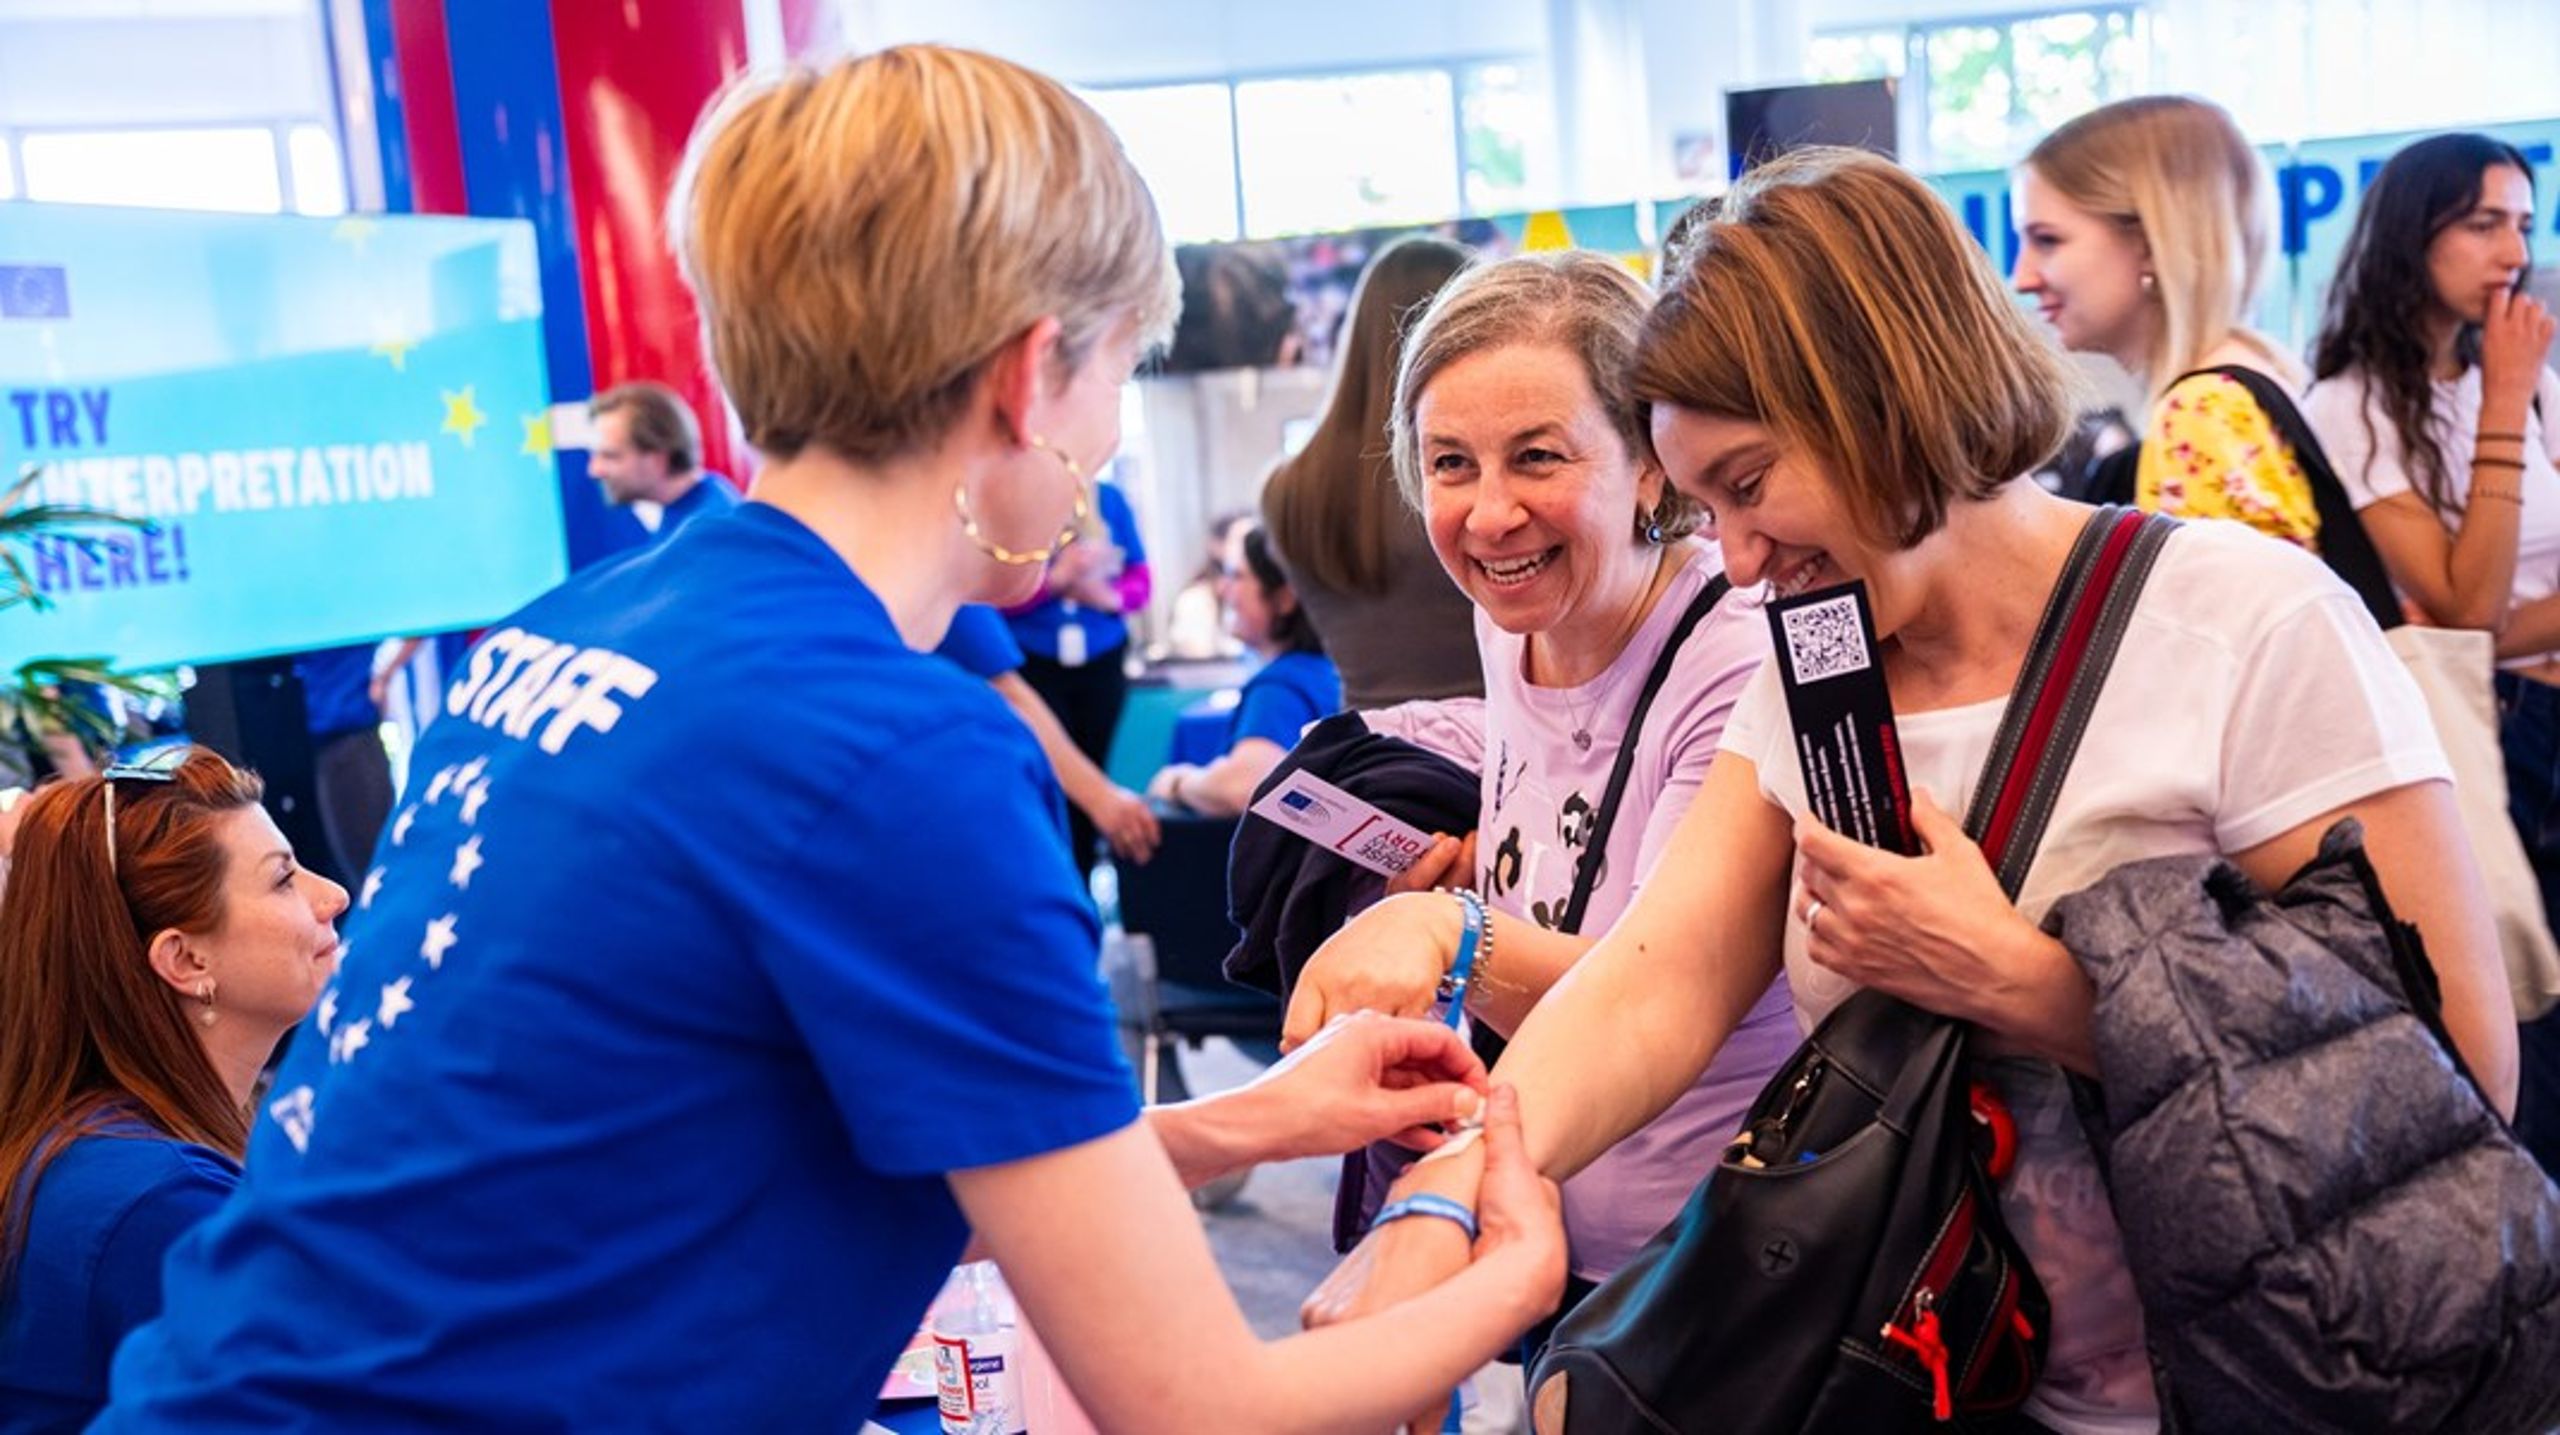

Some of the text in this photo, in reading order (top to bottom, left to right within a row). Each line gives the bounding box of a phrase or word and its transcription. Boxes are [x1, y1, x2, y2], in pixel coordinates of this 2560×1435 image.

[10, 387, 110, 448] TRY
[19, 441, 433, 517] INTERPRETATION
[33, 521, 190, 594] HERE!
[447, 627, 659, 756] STAFF
[1377, 829, 1428, 860] TORY
